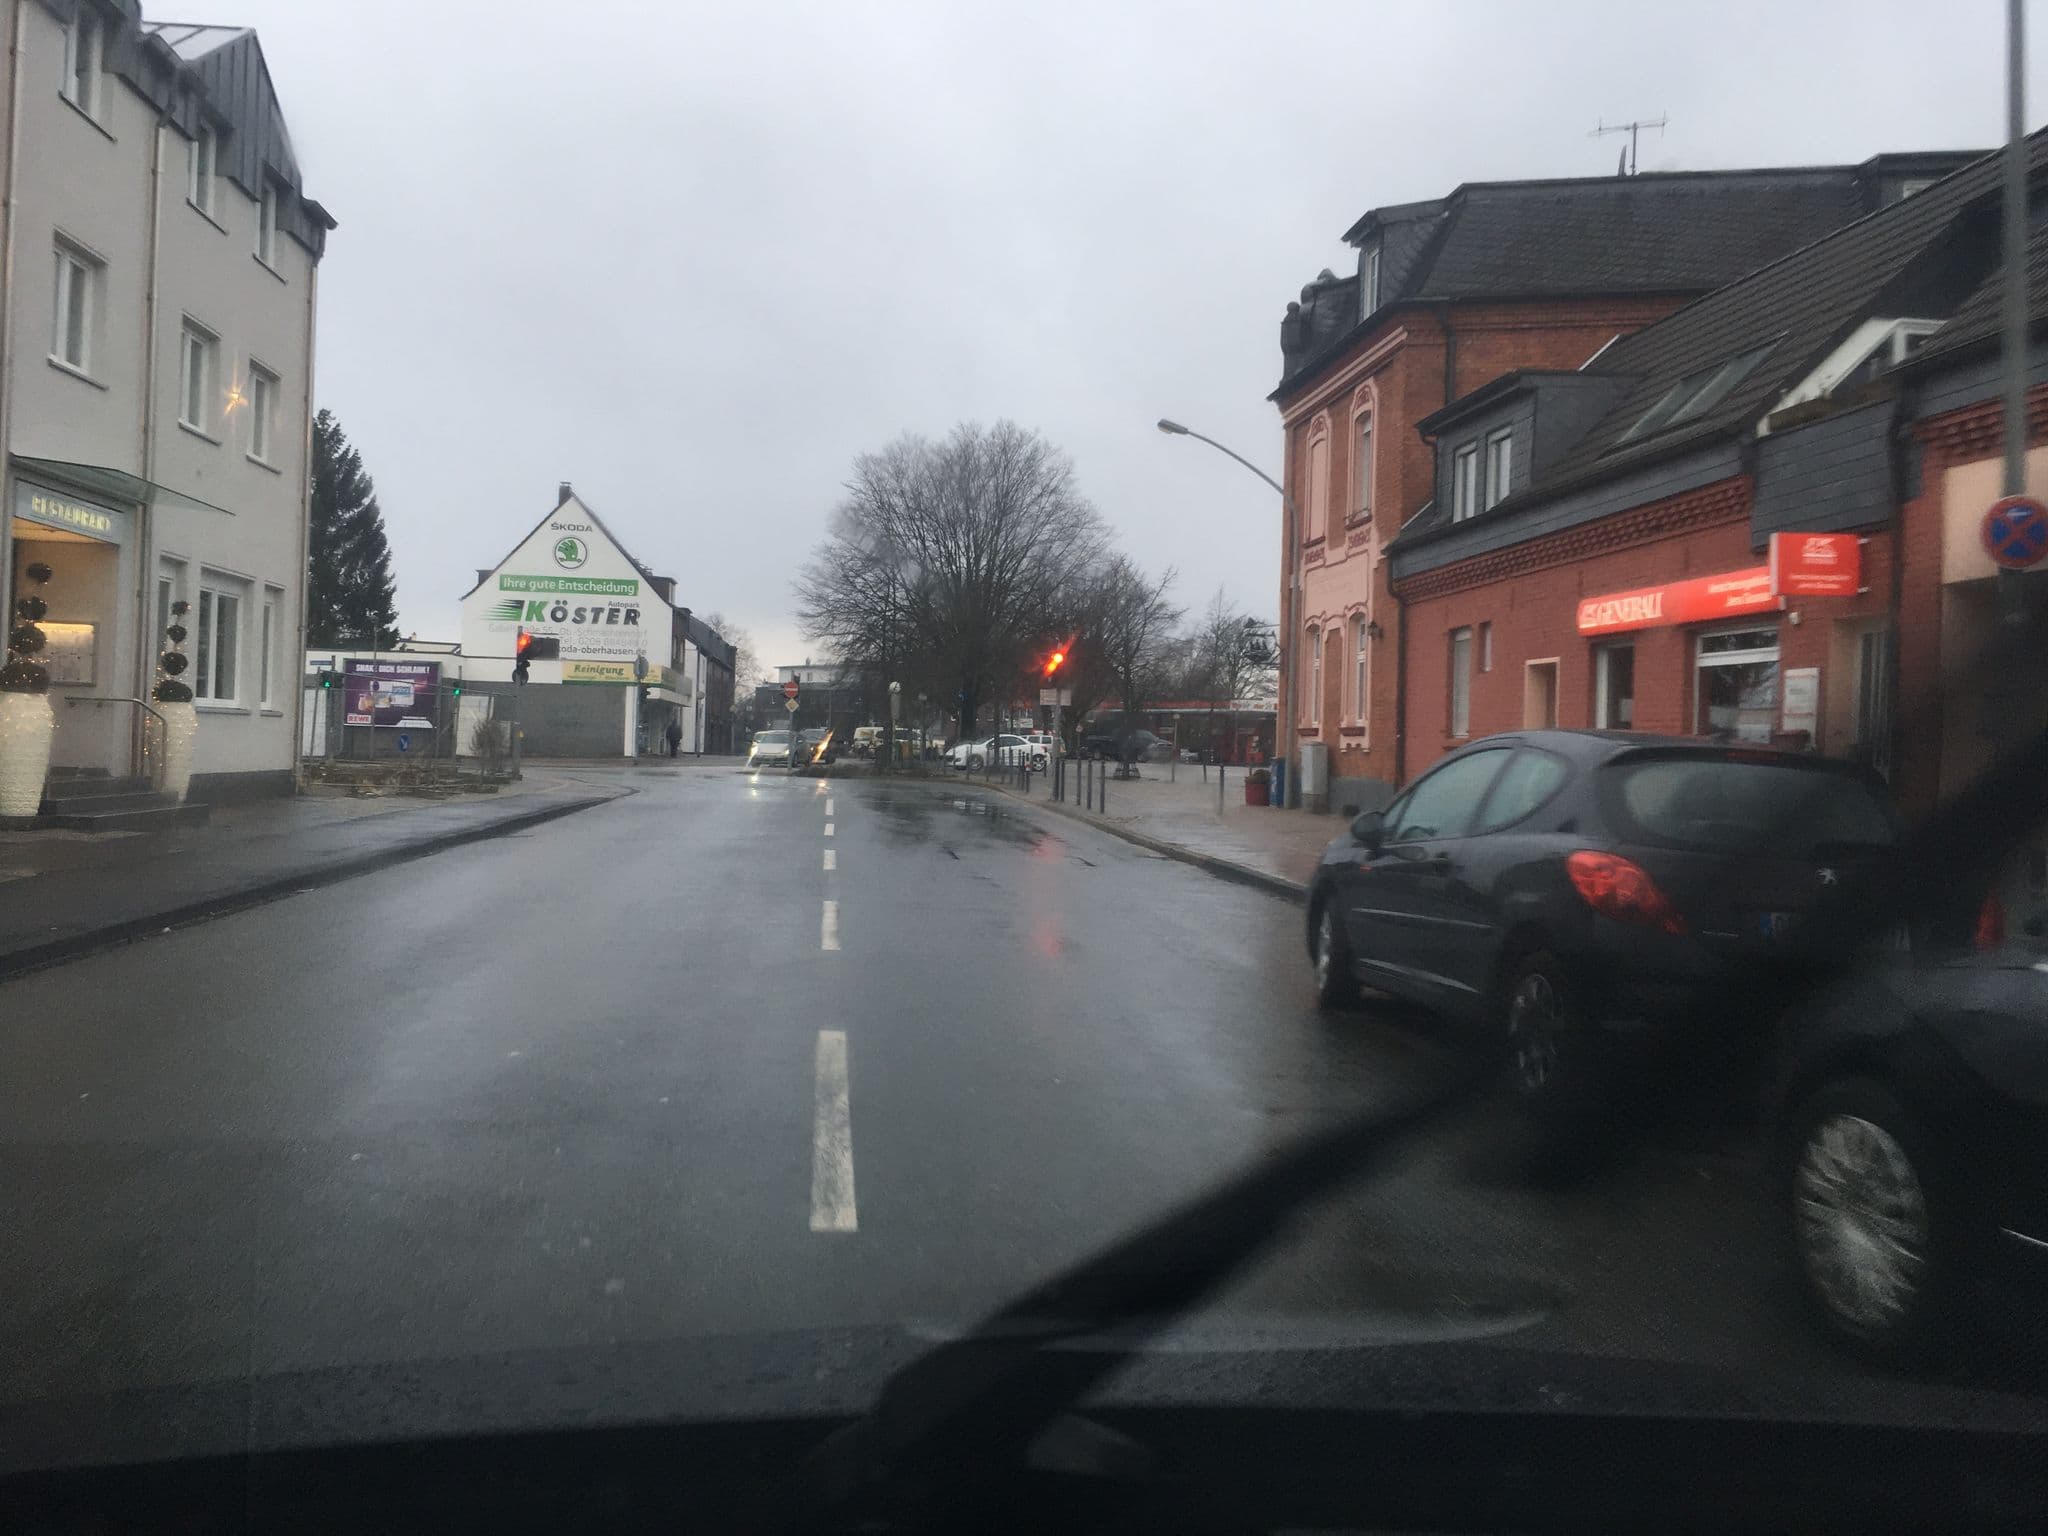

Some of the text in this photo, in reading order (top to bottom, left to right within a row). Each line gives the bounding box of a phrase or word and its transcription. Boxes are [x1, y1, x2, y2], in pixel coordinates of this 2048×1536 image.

[551, 522, 593, 532] ŠKODA
[503, 577, 635, 595] Ihre gute Entscheidung
[608, 601, 640, 609] Autopark
[1597, 592, 1664, 624] GENERALI
[526, 600, 641, 626] KÖSTER
[573, 664, 624, 676] Reinigung
